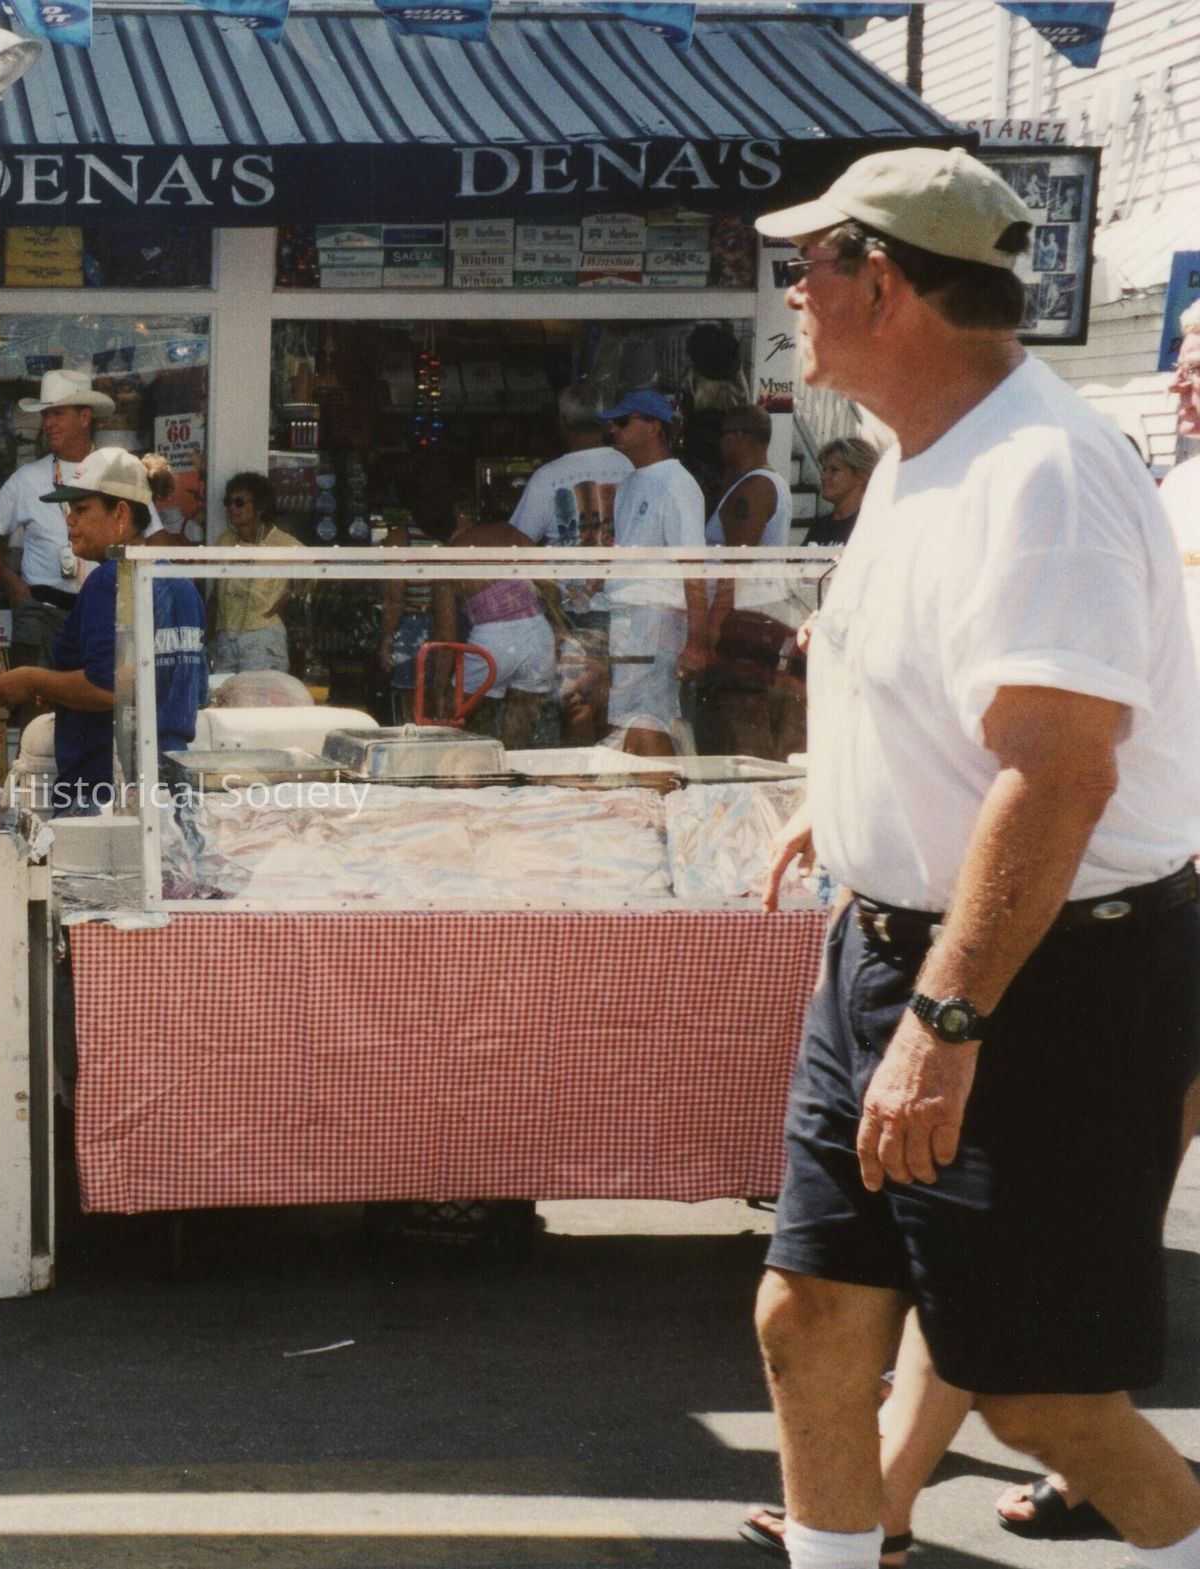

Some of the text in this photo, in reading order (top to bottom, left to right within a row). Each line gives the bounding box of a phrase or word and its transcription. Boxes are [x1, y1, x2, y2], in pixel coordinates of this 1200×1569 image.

[452, 139, 783, 198] DENA'S
[391, 250, 433, 263] SALEM
[460, 254, 505, 266] Winston
[586, 255, 635, 266] Winston
[654, 250, 706, 266] CAMEL
[522, 275, 563, 287] SALEM
[166, 424, 191, 442] 60
